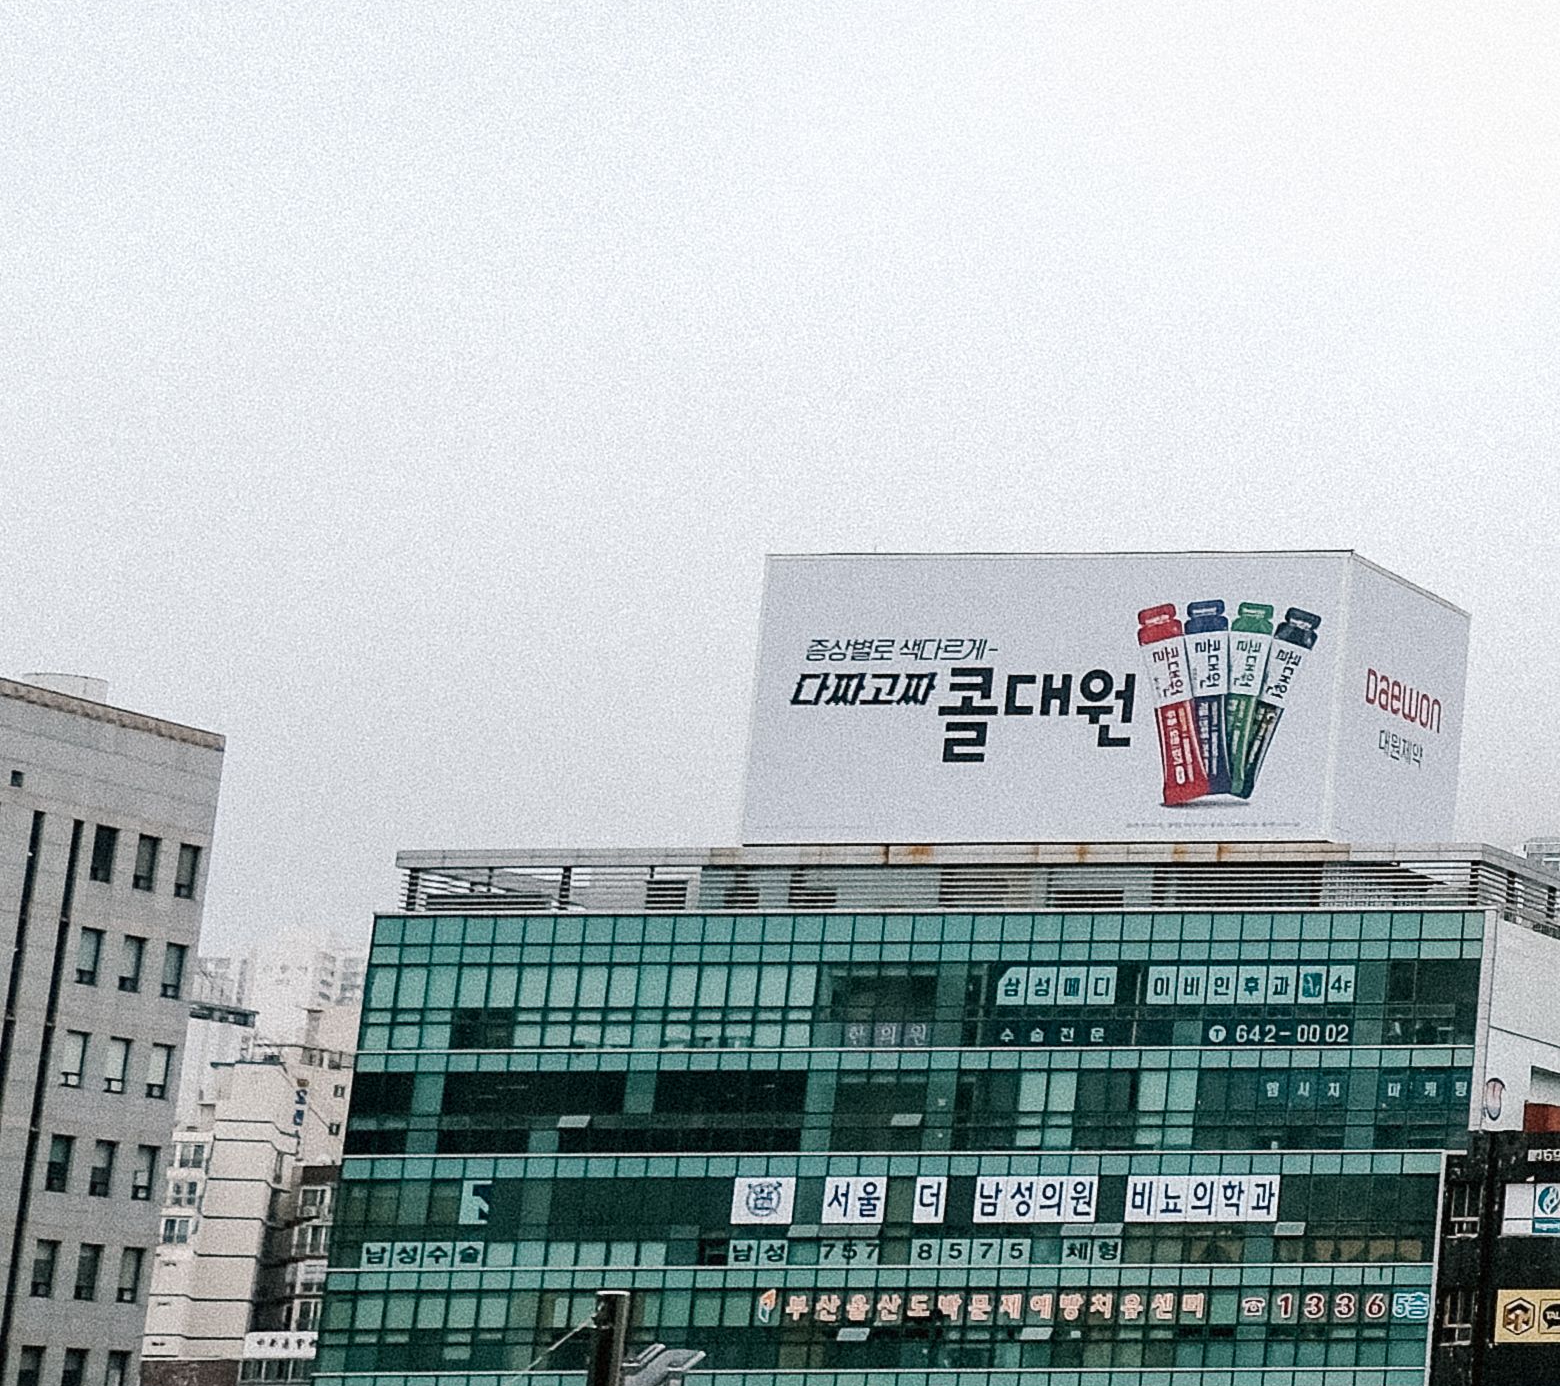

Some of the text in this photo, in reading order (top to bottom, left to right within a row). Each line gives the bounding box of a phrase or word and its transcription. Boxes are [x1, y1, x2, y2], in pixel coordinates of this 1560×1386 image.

[804, 638, 896, 661] 증상별로
[790, 667, 1135, 763] 다짜고짜 콜대원
[1378, 728, 1425, 770] 대원제약
[1003, 976, 1354, 999] 삼성메디 이비인후과 4F
[1000, 1026, 1105, 1045] 수술전문
[1235, 1023, 1350, 1044] 642-0002
[826, 1177, 1278, 1219] 서울 더 남성의원 비뇨의학과
[366, 1245, 481, 1265] 남성수술
[731, 1240, 1121, 1266] 남성 757 8575 체형
[1277, 1292, 1386, 1319] 1336
